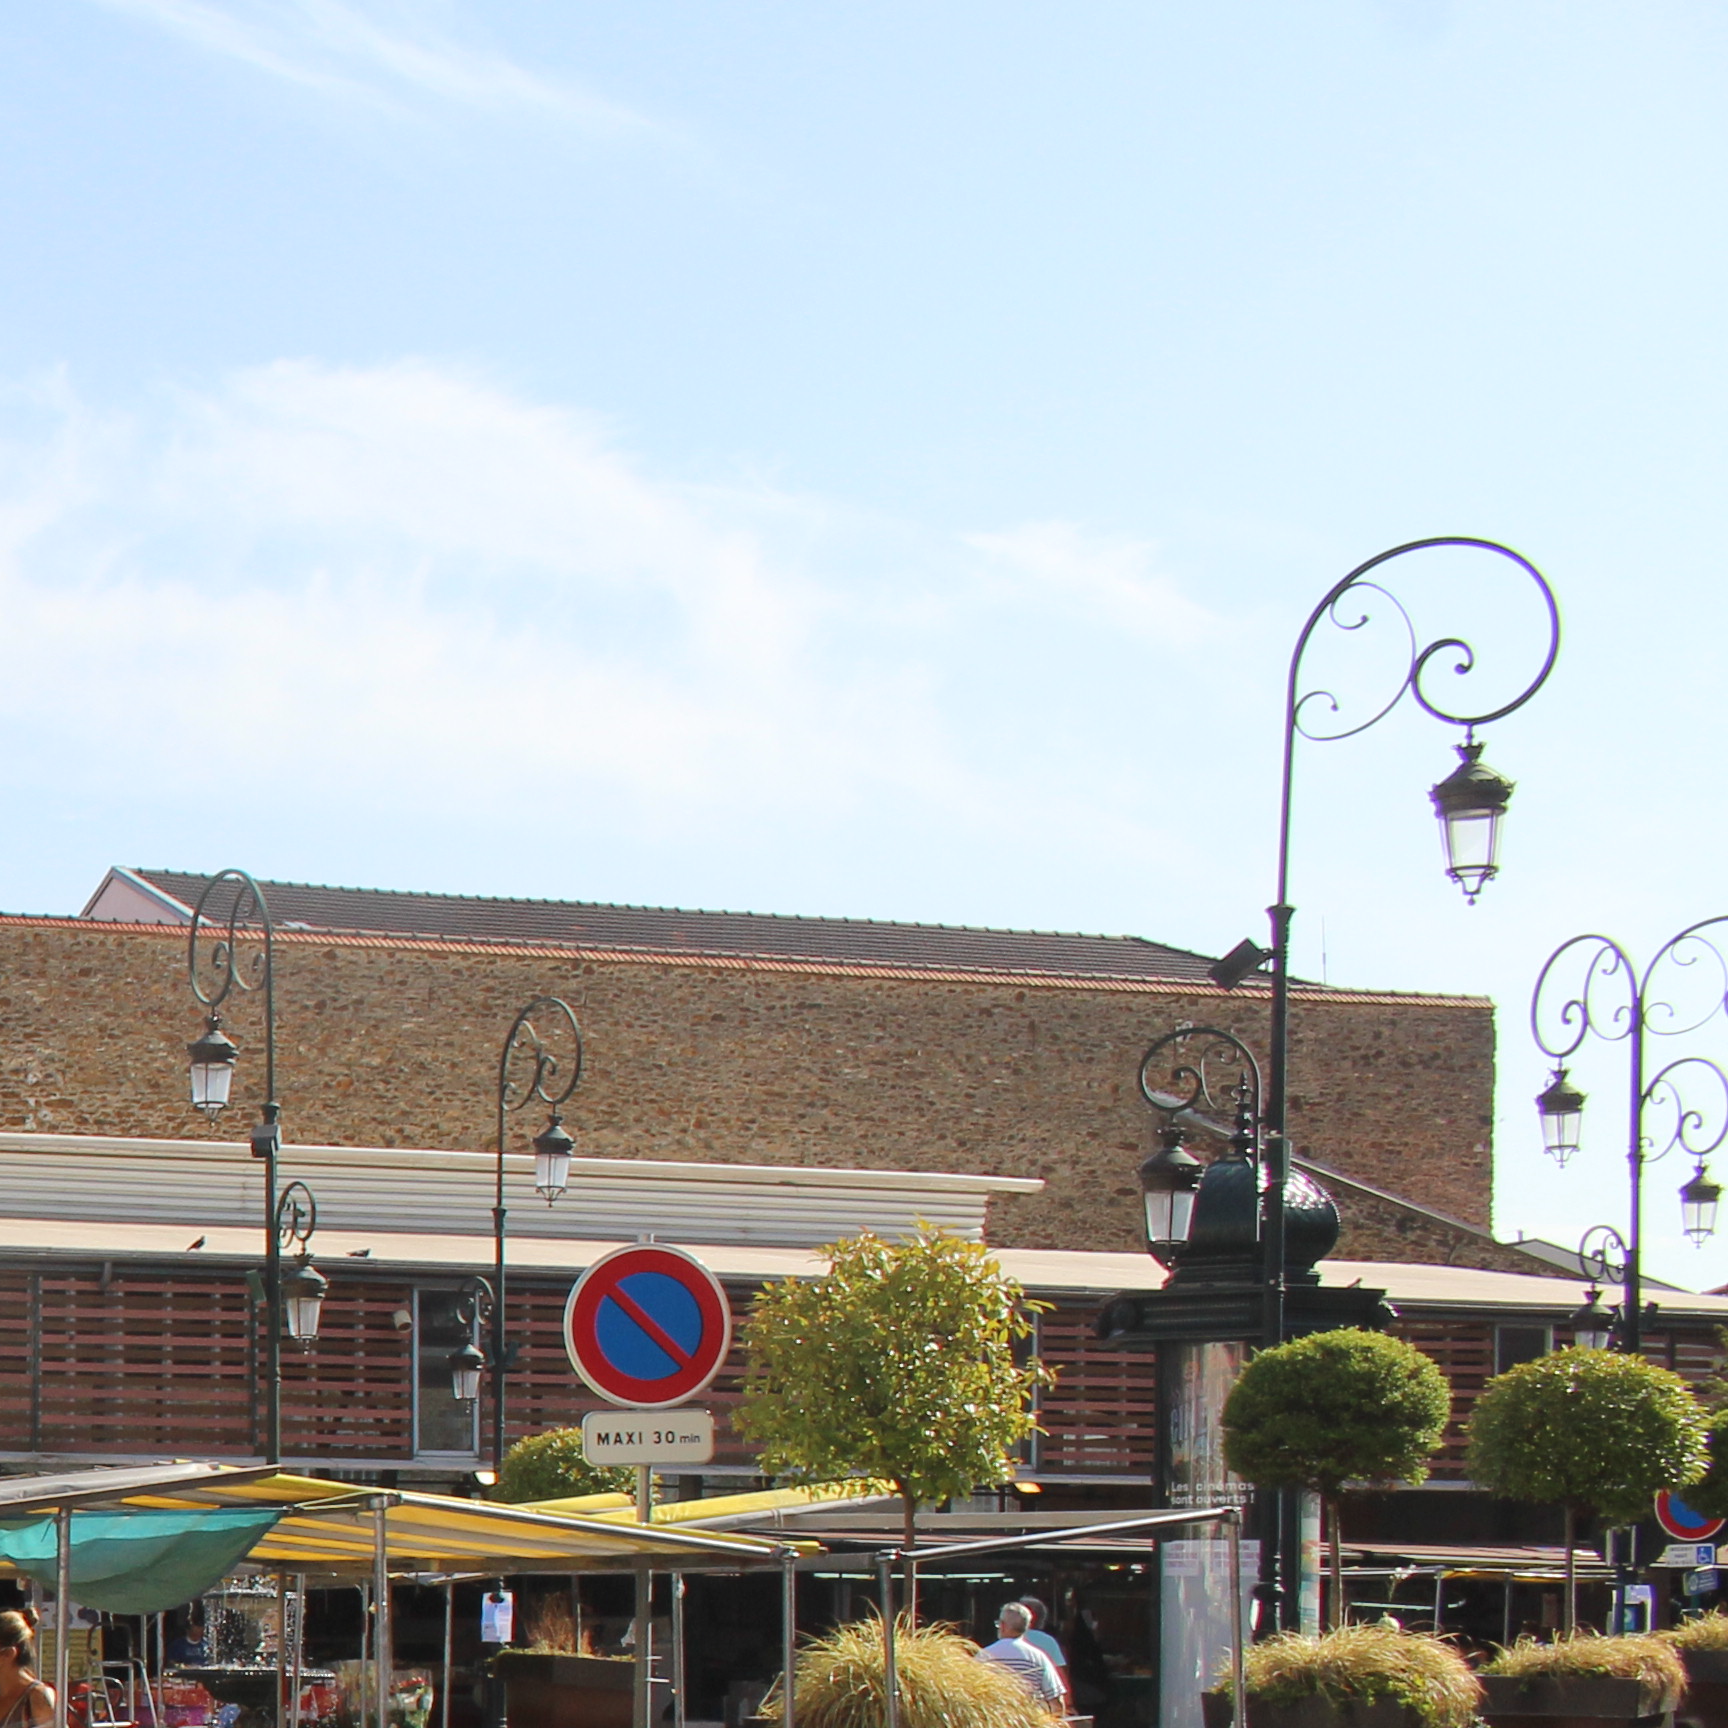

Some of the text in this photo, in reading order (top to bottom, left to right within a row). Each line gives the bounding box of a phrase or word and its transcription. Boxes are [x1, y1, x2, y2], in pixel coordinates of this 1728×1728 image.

[597, 1431, 701, 1446] MAXI 30 min
[1171, 1480, 1255, 1492] Les cinémas
[1171, 1494, 1193, 1504] sont
[1196, 1494, 1247, 1504] ouverts
